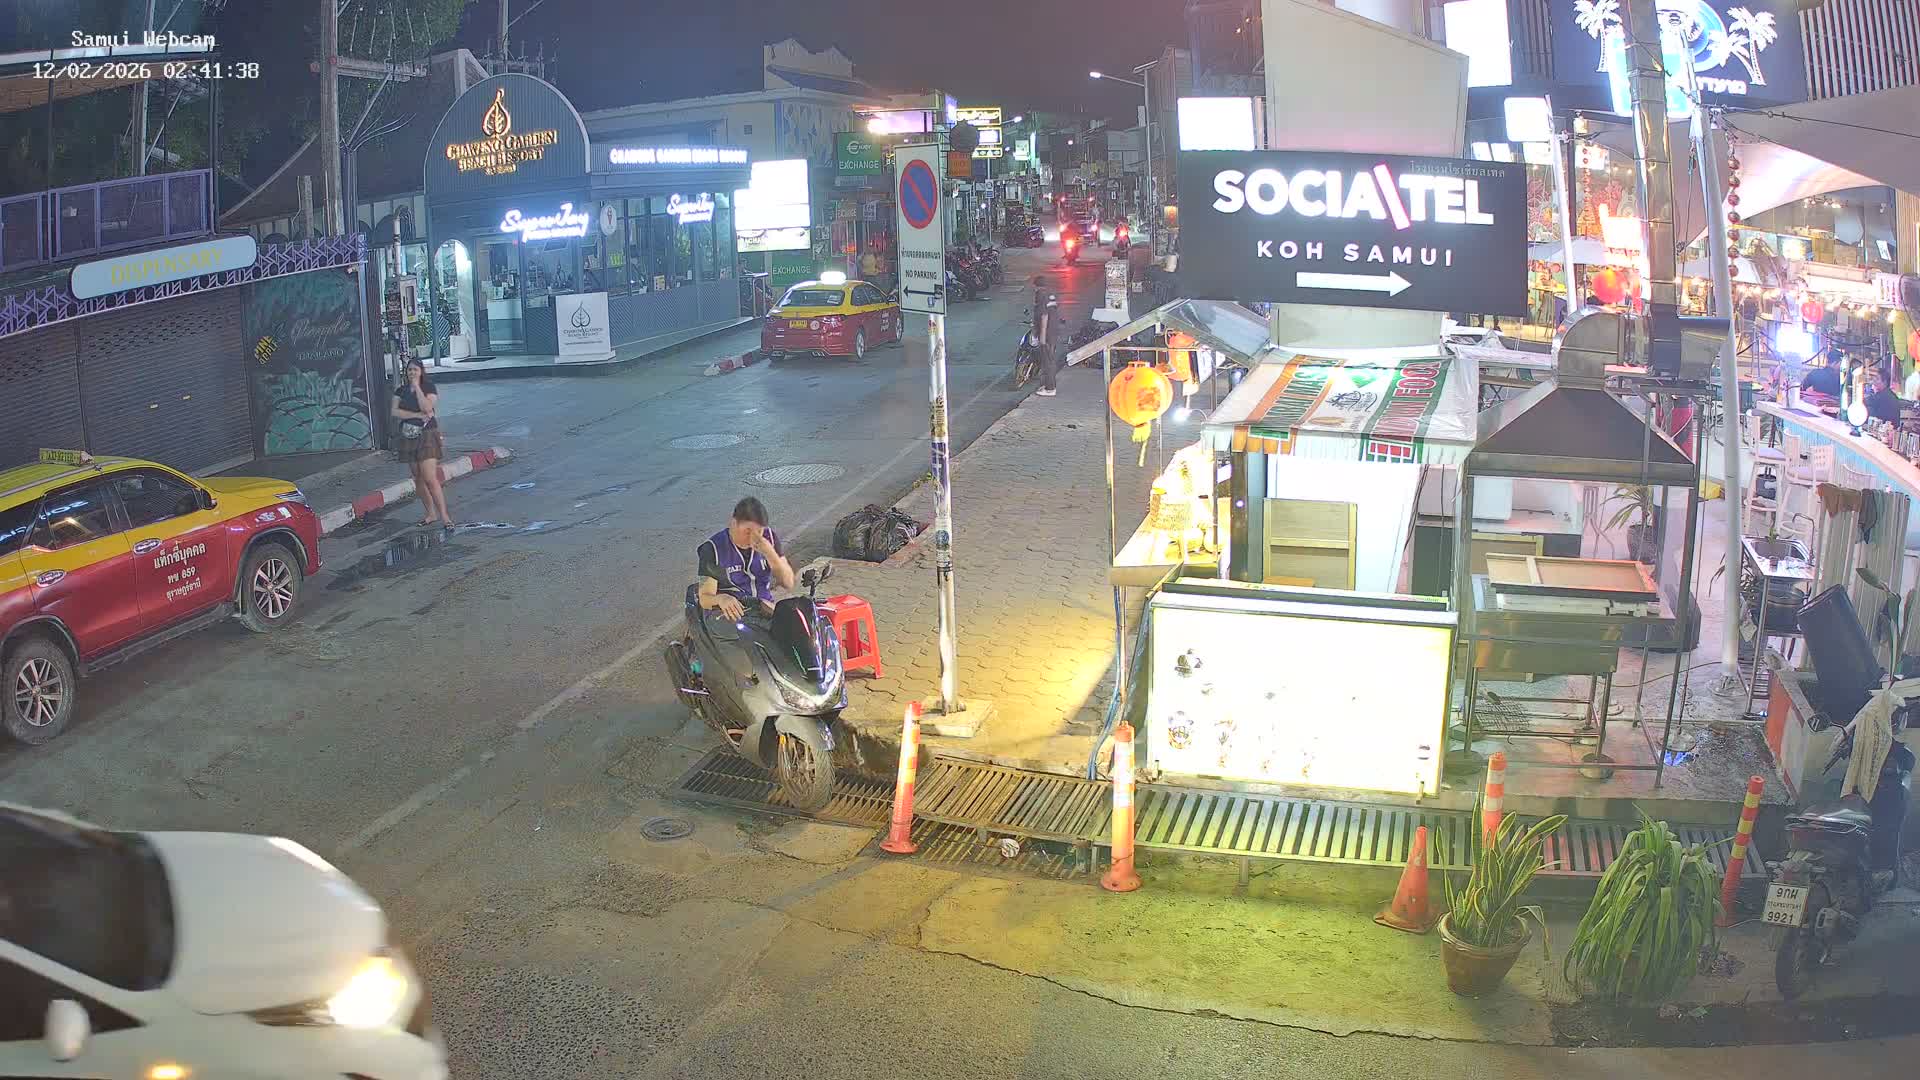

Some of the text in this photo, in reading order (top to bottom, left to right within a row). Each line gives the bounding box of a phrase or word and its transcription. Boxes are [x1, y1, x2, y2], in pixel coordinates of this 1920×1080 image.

[838, 159, 880, 170] EXCHANGE
[1256, 239, 1453, 267] KOH SAMUI
[111, 247, 223, 287] DISPENSARY
[772, 265, 812, 275] EXCHANGE
[905, 269, 938, 280] NO PARKING
[181, 566, 196, 579] 859
[1767, 911, 1794, 924] 9921
